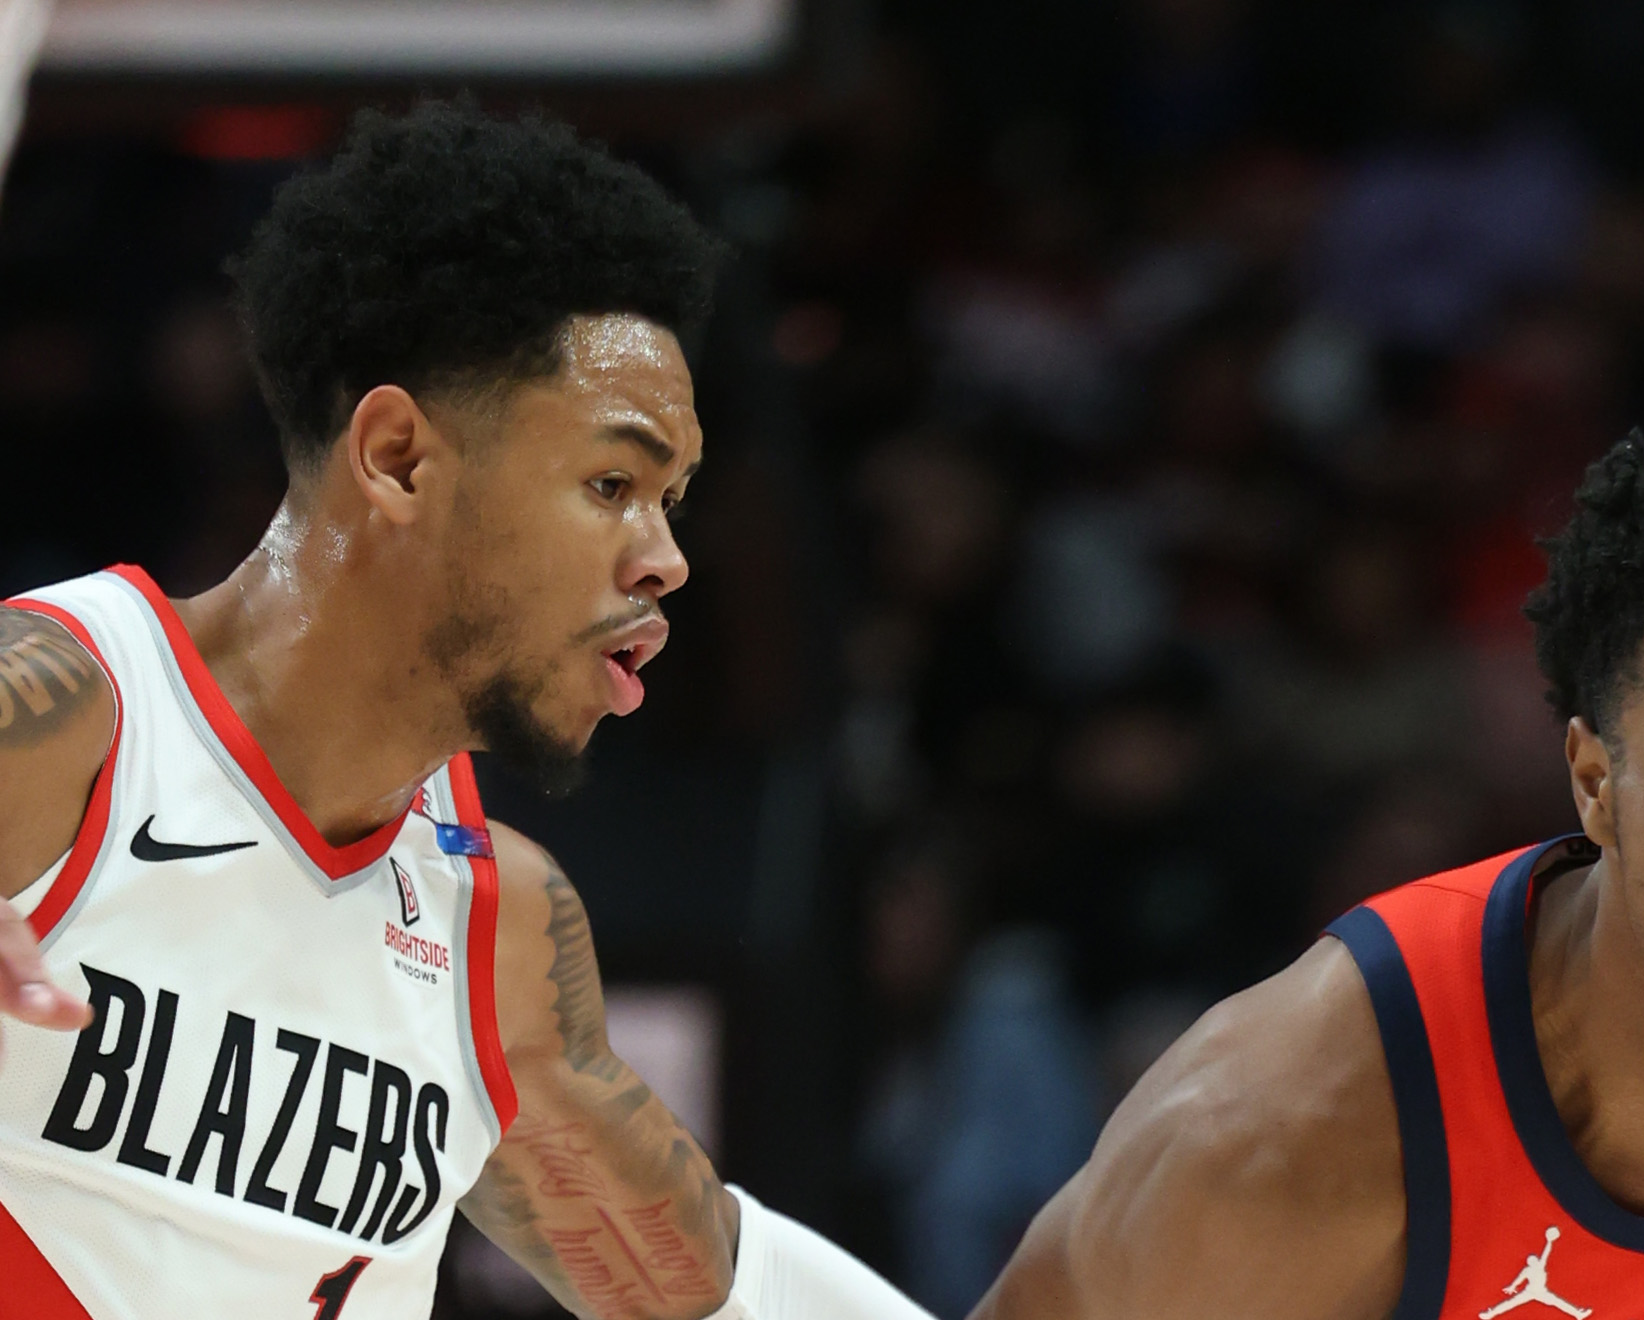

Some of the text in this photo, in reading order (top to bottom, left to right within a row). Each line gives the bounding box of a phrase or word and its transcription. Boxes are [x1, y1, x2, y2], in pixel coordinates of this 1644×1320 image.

[384, 920, 450, 972] BRIGHTSIDE
[393, 957, 438, 985] WINDOWS
[42, 962, 450, 1246] BLAZERS
